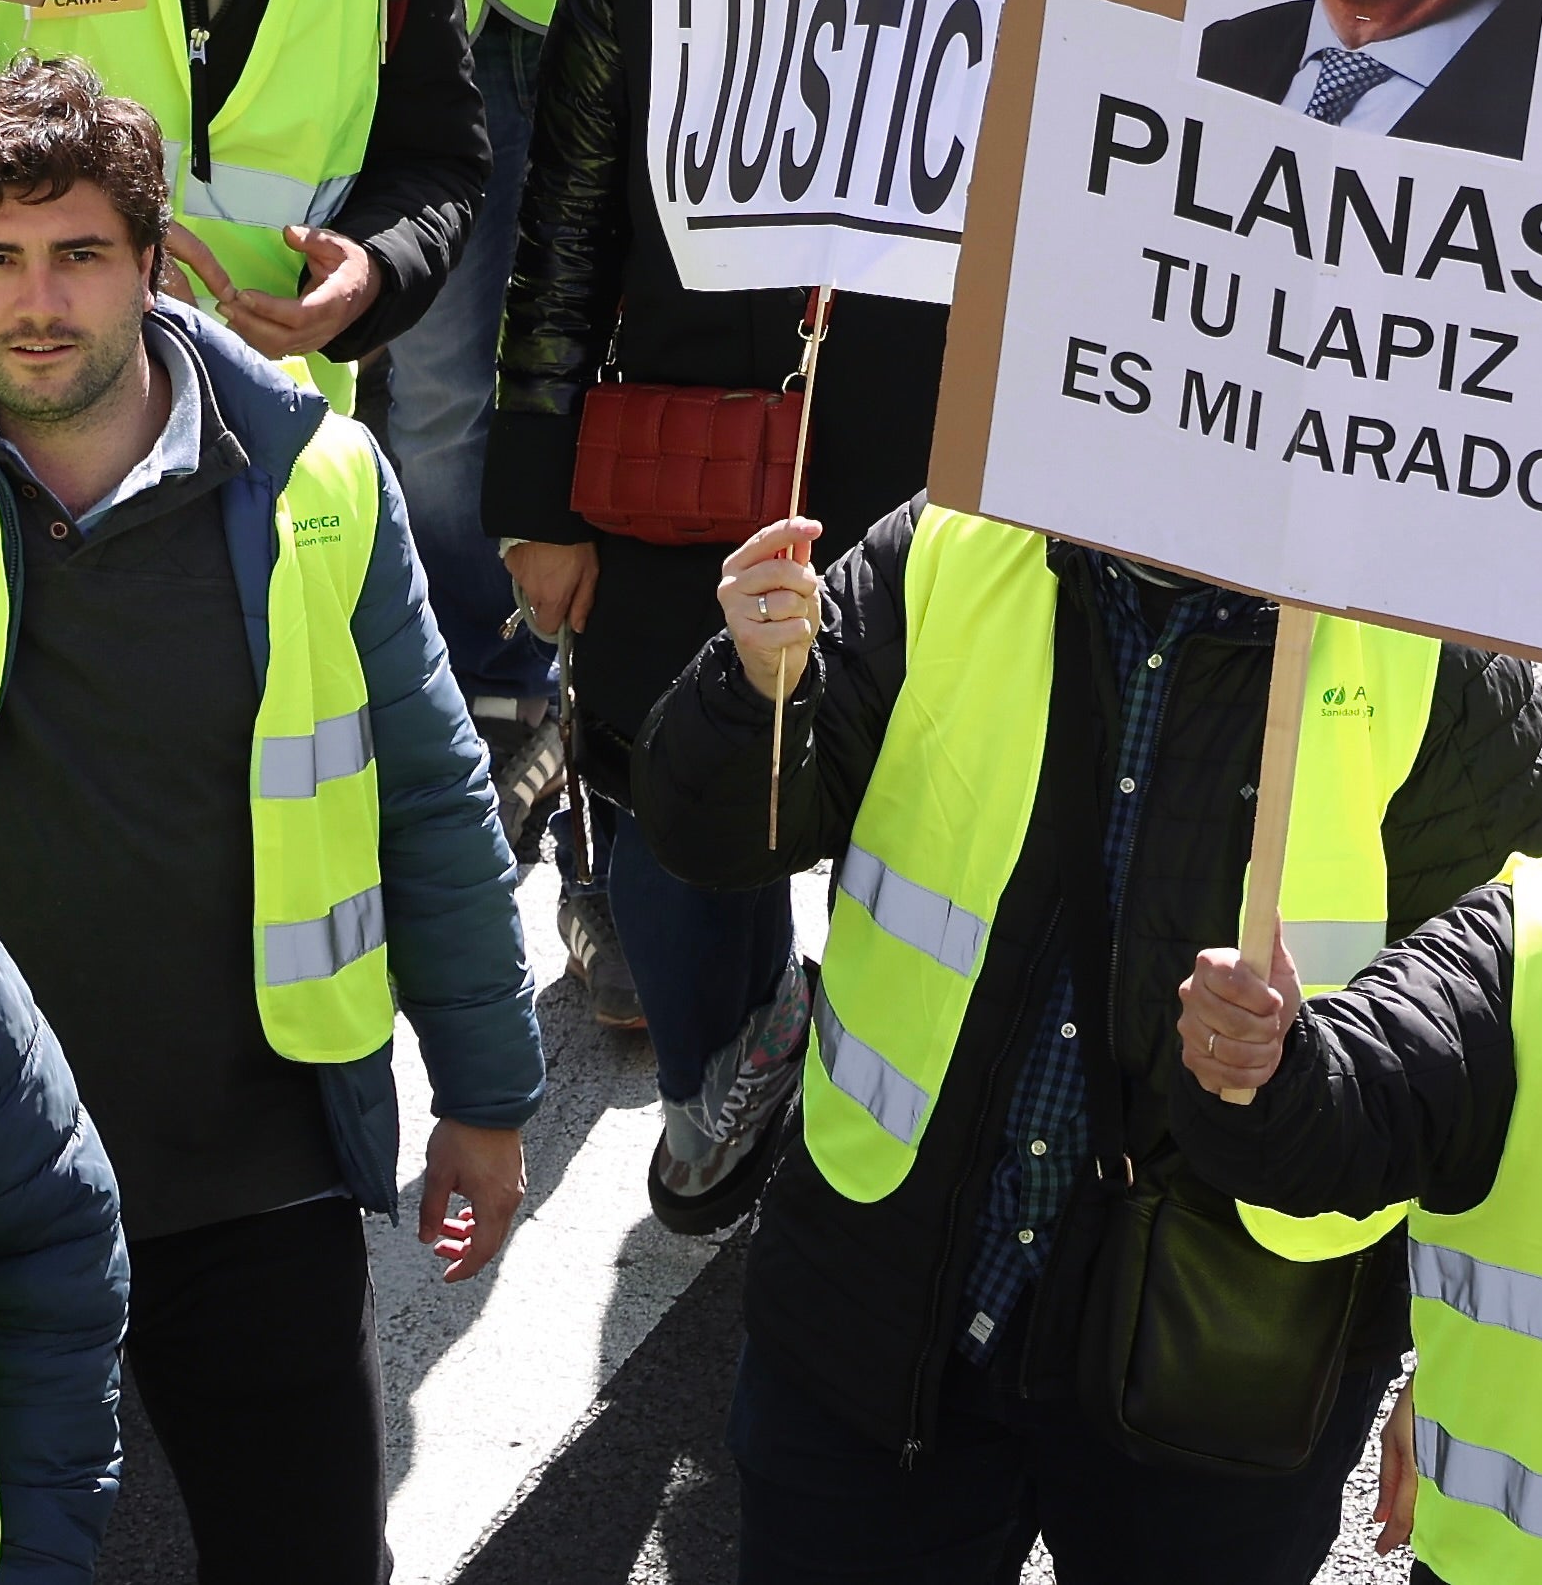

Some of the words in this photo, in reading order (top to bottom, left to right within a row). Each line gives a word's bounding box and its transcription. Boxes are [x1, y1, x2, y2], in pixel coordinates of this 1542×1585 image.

[1142, 247, 1241, 338] TU
[1266, 287, 1519, 403] LAPIZ
[1061, 336, 1153, 415] ES
[1179, 368, 1263, 451] MI
